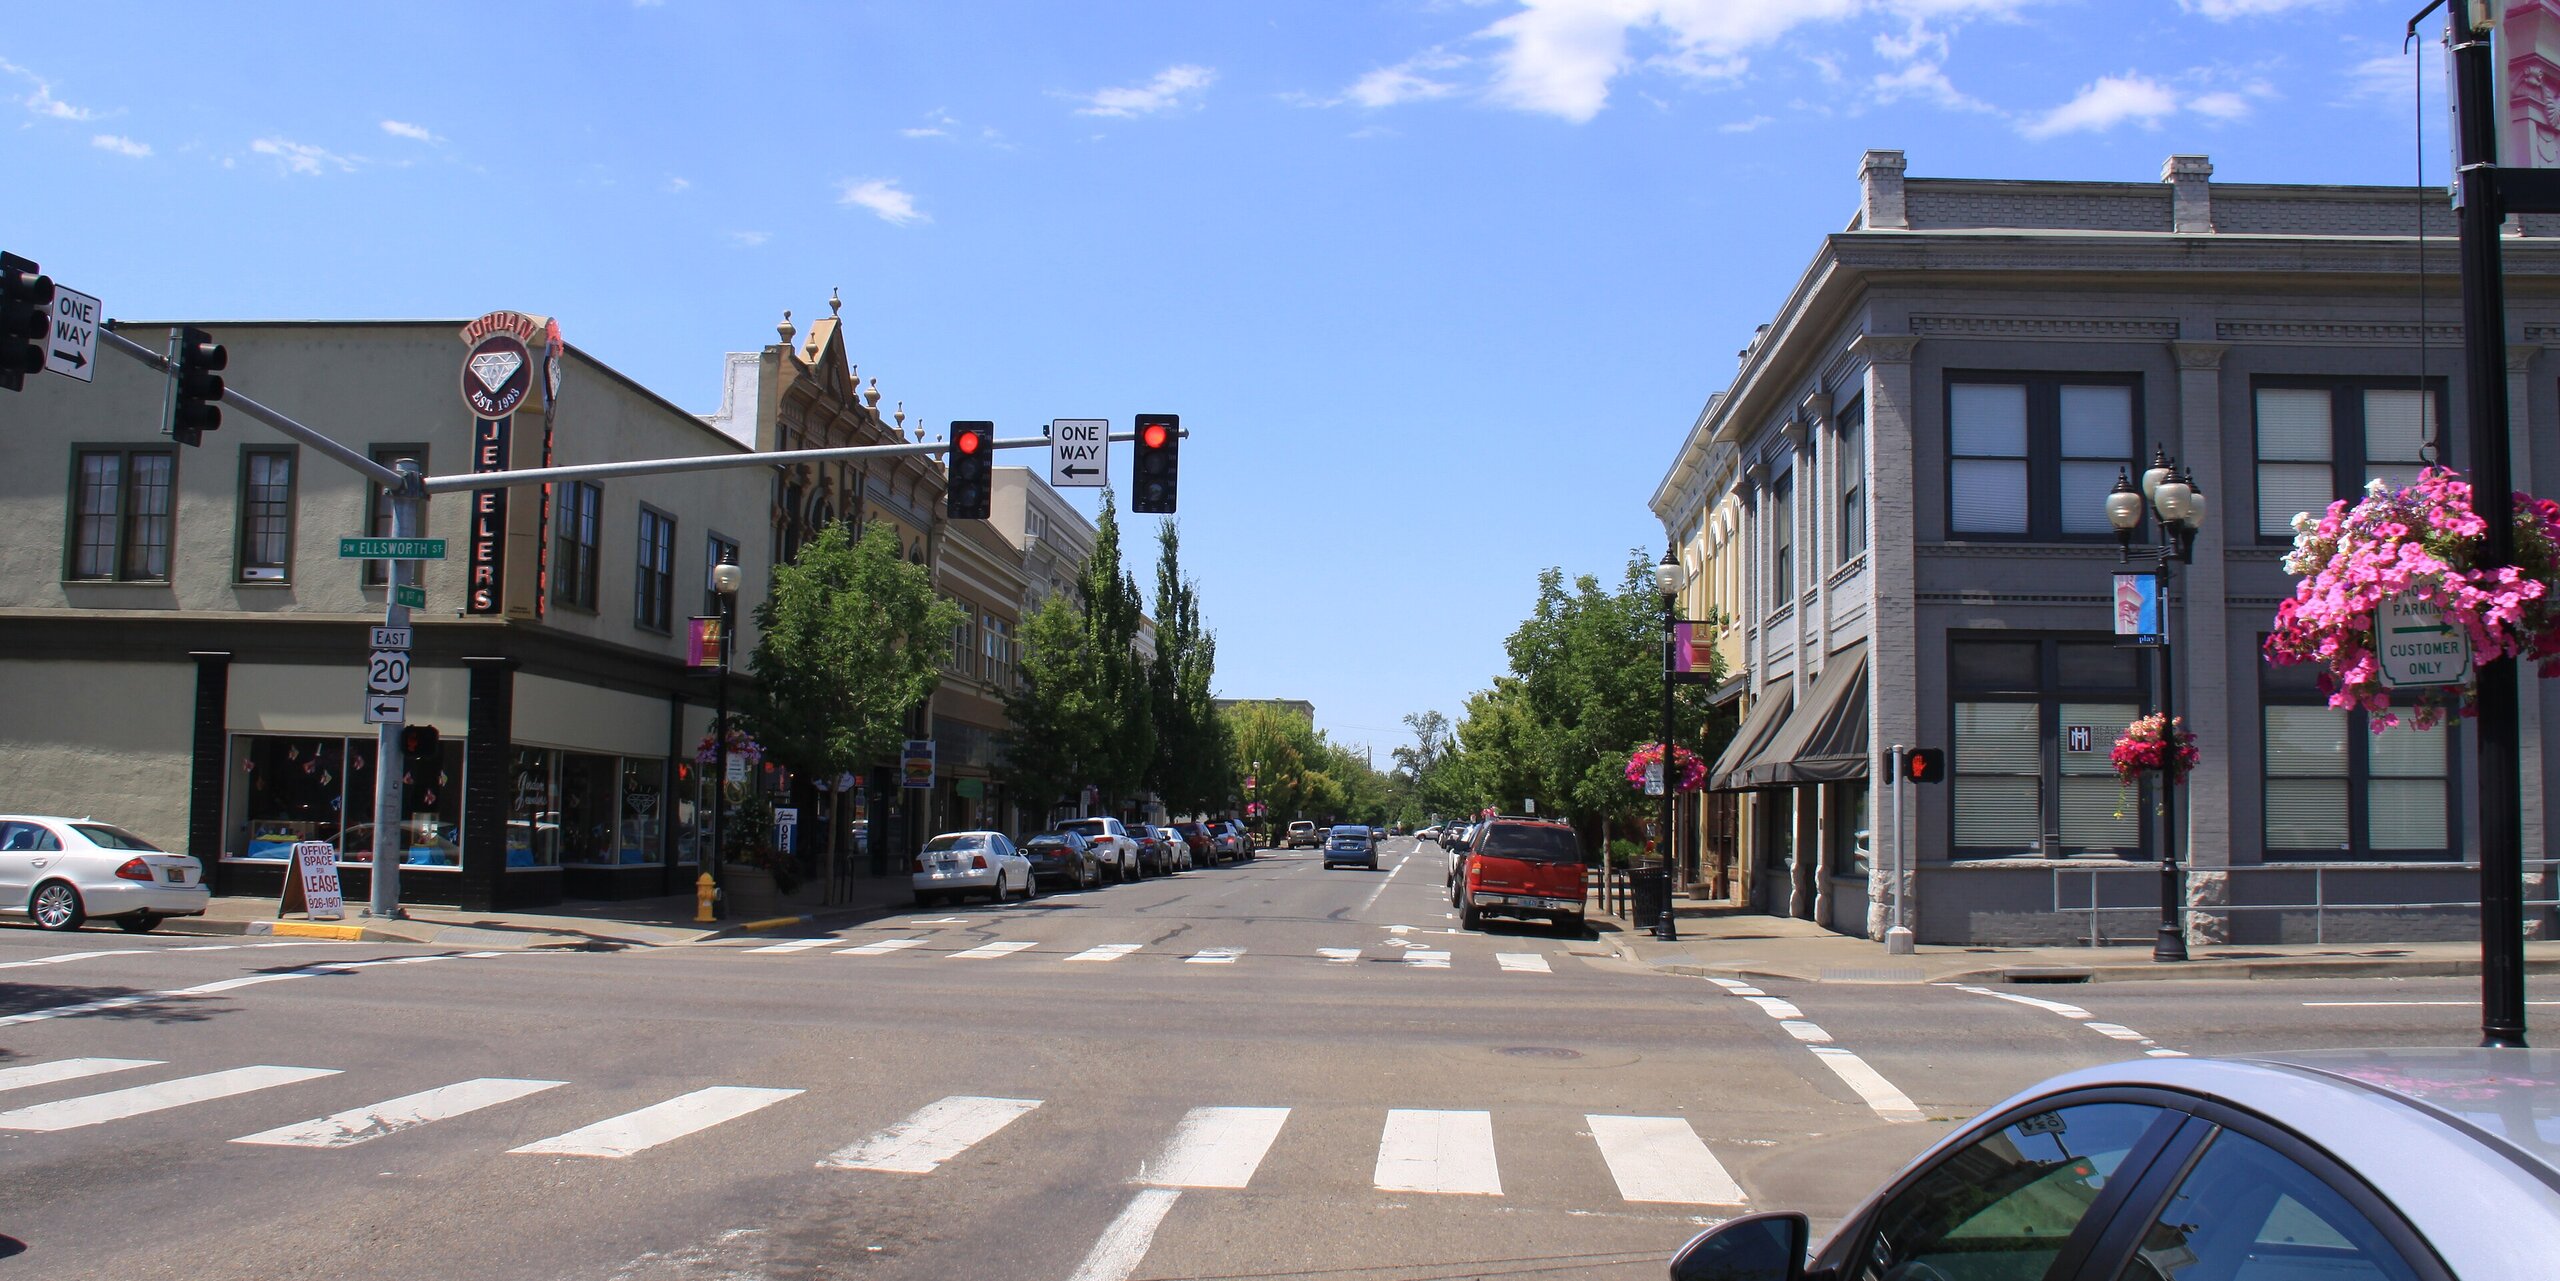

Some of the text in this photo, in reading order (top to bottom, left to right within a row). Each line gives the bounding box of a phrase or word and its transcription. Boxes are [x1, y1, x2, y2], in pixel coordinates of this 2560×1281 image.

[60, 297, 93, 324] ONE
[57, 320, 92, 347] WAY
[466, 312, 536, 345] JORDAN
[472, 388, 520, 412] EST. 1993
[1061, 426, 1099, 441] ONE
[1060, 445, 1099, 460] WAY
[474, 421, 500, 610] JEELERS
[343, 544, 356, 552] SW
[360, 542, 428, 555] ELLSWORTH
[2392, 601, 2443, 617] PARKIN
[376, 631, 406, 645] EAST
[2390, 642, 2459, 657] CUSTOMER
[373, 659, 405, 683] 20
[2409, 662, 2442, 675] ONLY
[301, 845, 333, 855] OFFICE
[304, 856, 333, 867] SPACE
[305, 875, 339, 892] LEASE
[308, 896, 341, 909] 926-1907
